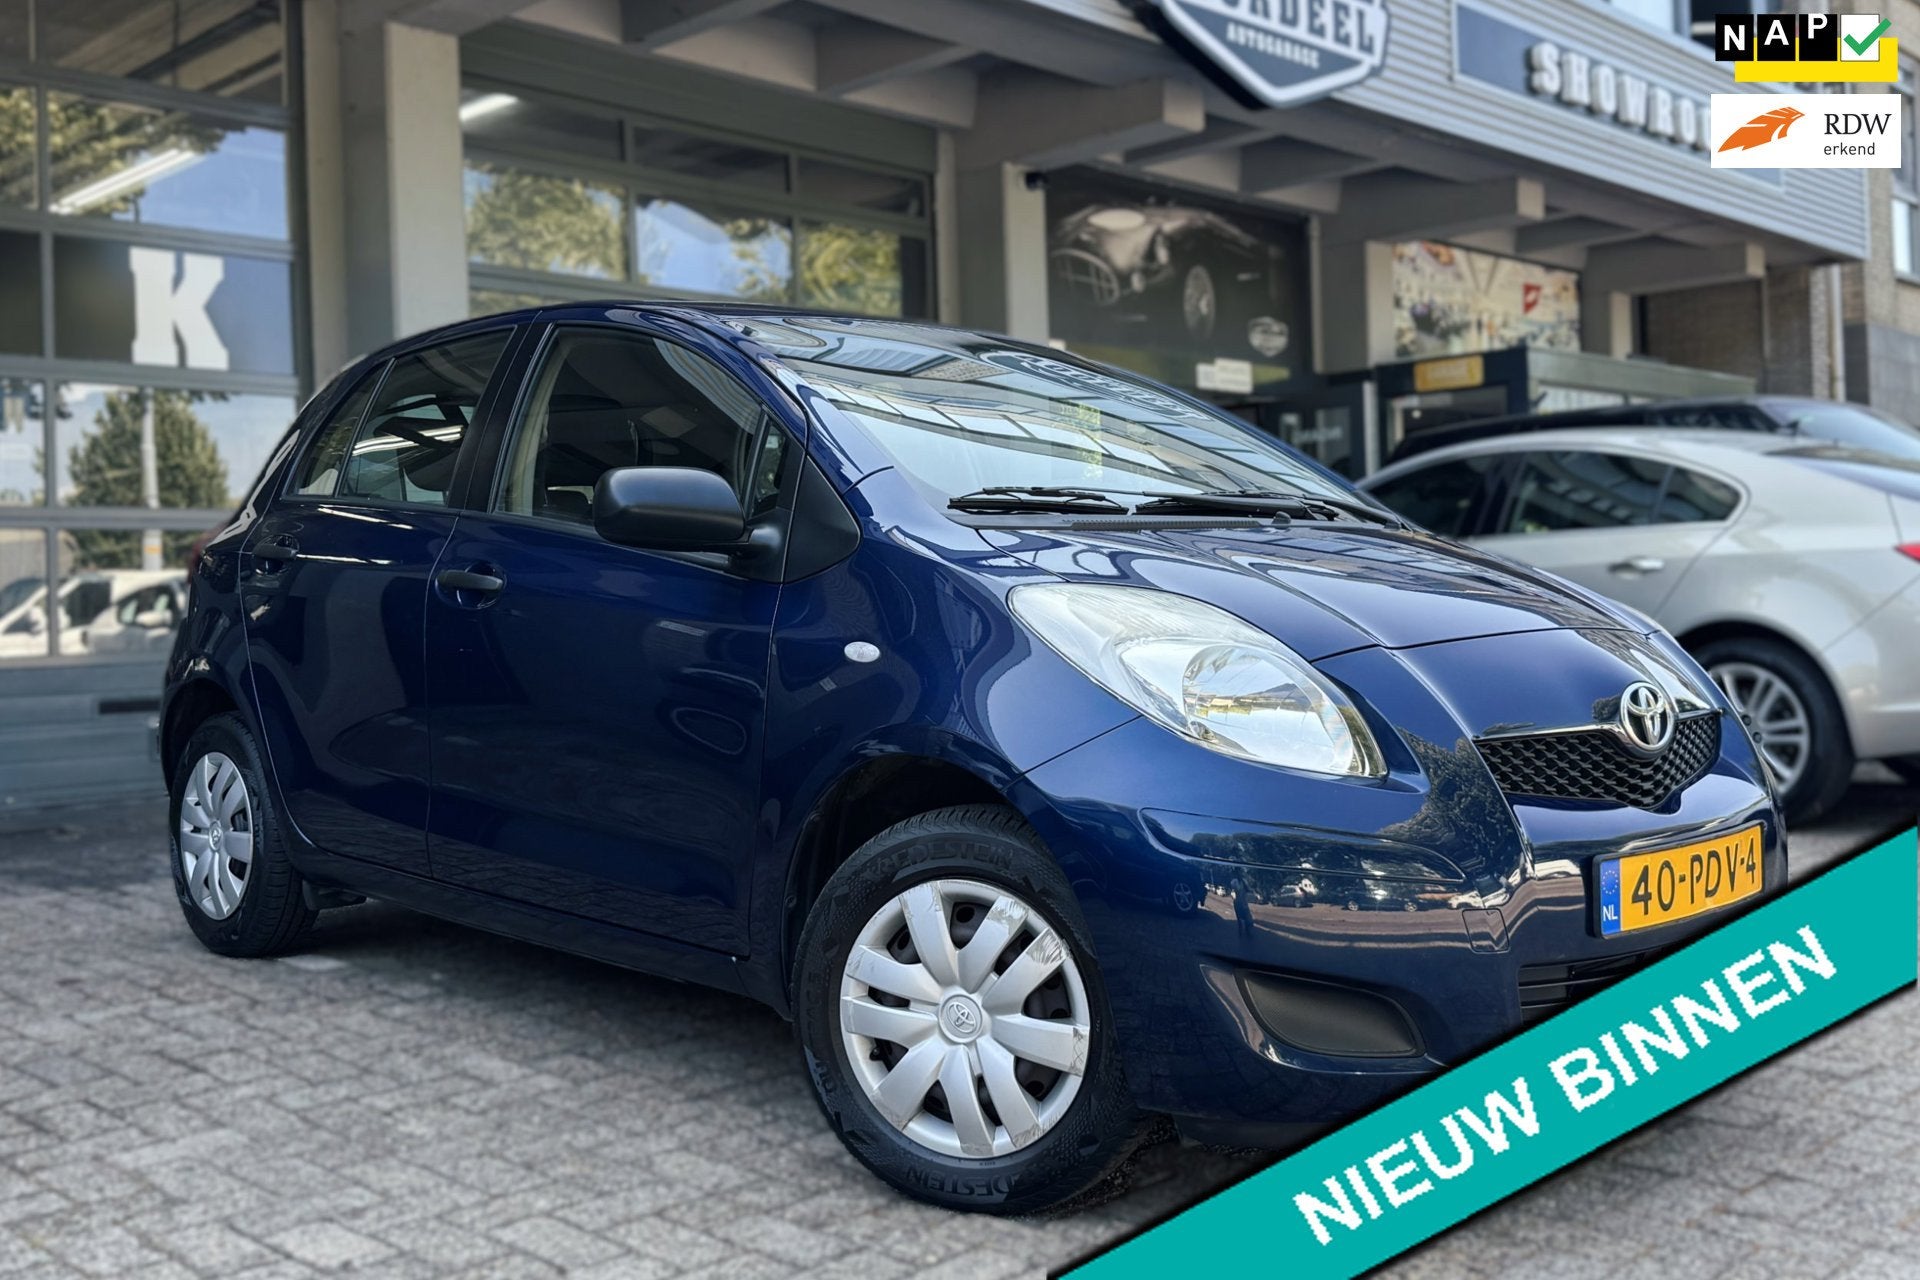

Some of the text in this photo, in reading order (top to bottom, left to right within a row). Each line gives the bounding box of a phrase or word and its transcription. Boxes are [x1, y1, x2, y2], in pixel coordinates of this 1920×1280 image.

[1220, 0, 1375, 57] DEEL
[130, 247, 228, 370] K
[1631, 835, 1756, 916] 40-PDV-4
[1603, 905, 1618, 921] NL
